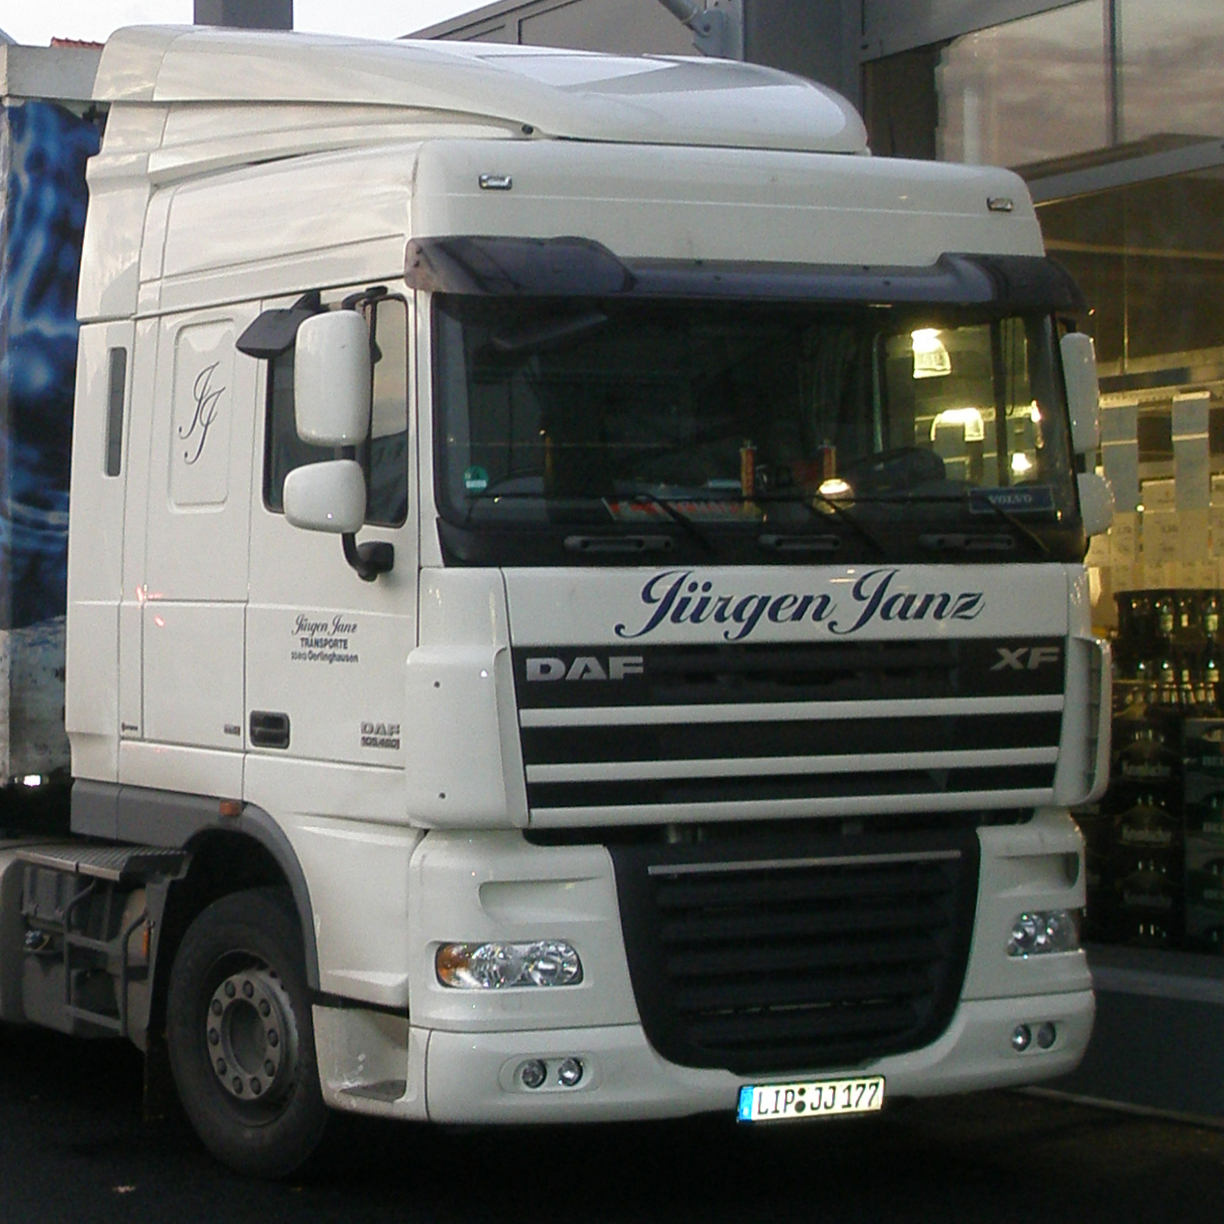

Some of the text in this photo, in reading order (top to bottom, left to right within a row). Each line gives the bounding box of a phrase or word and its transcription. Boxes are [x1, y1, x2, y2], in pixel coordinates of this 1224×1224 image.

[988, 493, 1032, 506] VOLVO
[614, 568, 987, 642] Jürgen Janz
[291, 613, 358, 637] Jürgen Janz
[299, 636, 349, 650] TRANSPORTE
[307, 649, 359, 664] Oerlinghausen
[525, 656, 644, 681] DAF
[989, 647, 1061, 671] XF
[361, 720, 401, 736] DAF
[757, 1082, 880, 1115] LIP JJ 177
